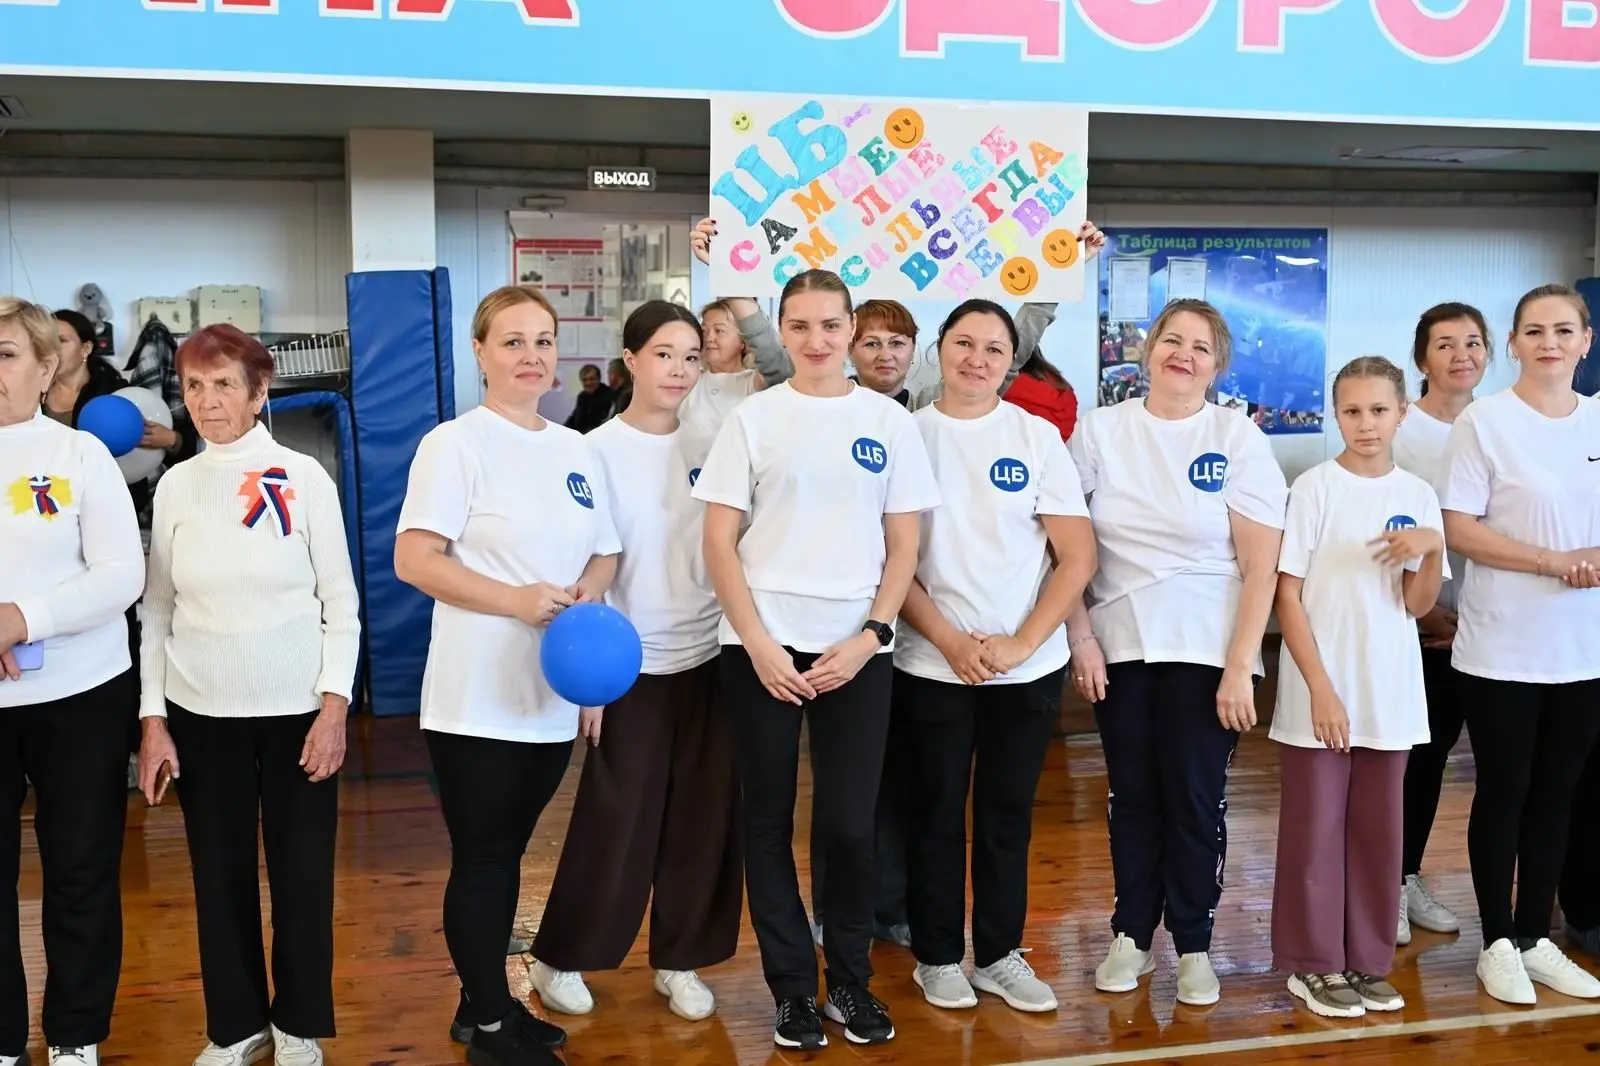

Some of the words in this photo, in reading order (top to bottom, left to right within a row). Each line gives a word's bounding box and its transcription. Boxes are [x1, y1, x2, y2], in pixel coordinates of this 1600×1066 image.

[712, 100, 847, 227] ЦБ
[594, 171, 650, 186] ВЫХОД
[729, 136, 898, 273] САМЫЕ
[899, 140, 1064, 291] ВСЕГДА
[1117, 234, 1197, 250] Таблица
[1203, 236, 1311, 251] результатов
[855, 443, 884, 465] ЦБ
[994, 465, 1025, 484] ЦБ
